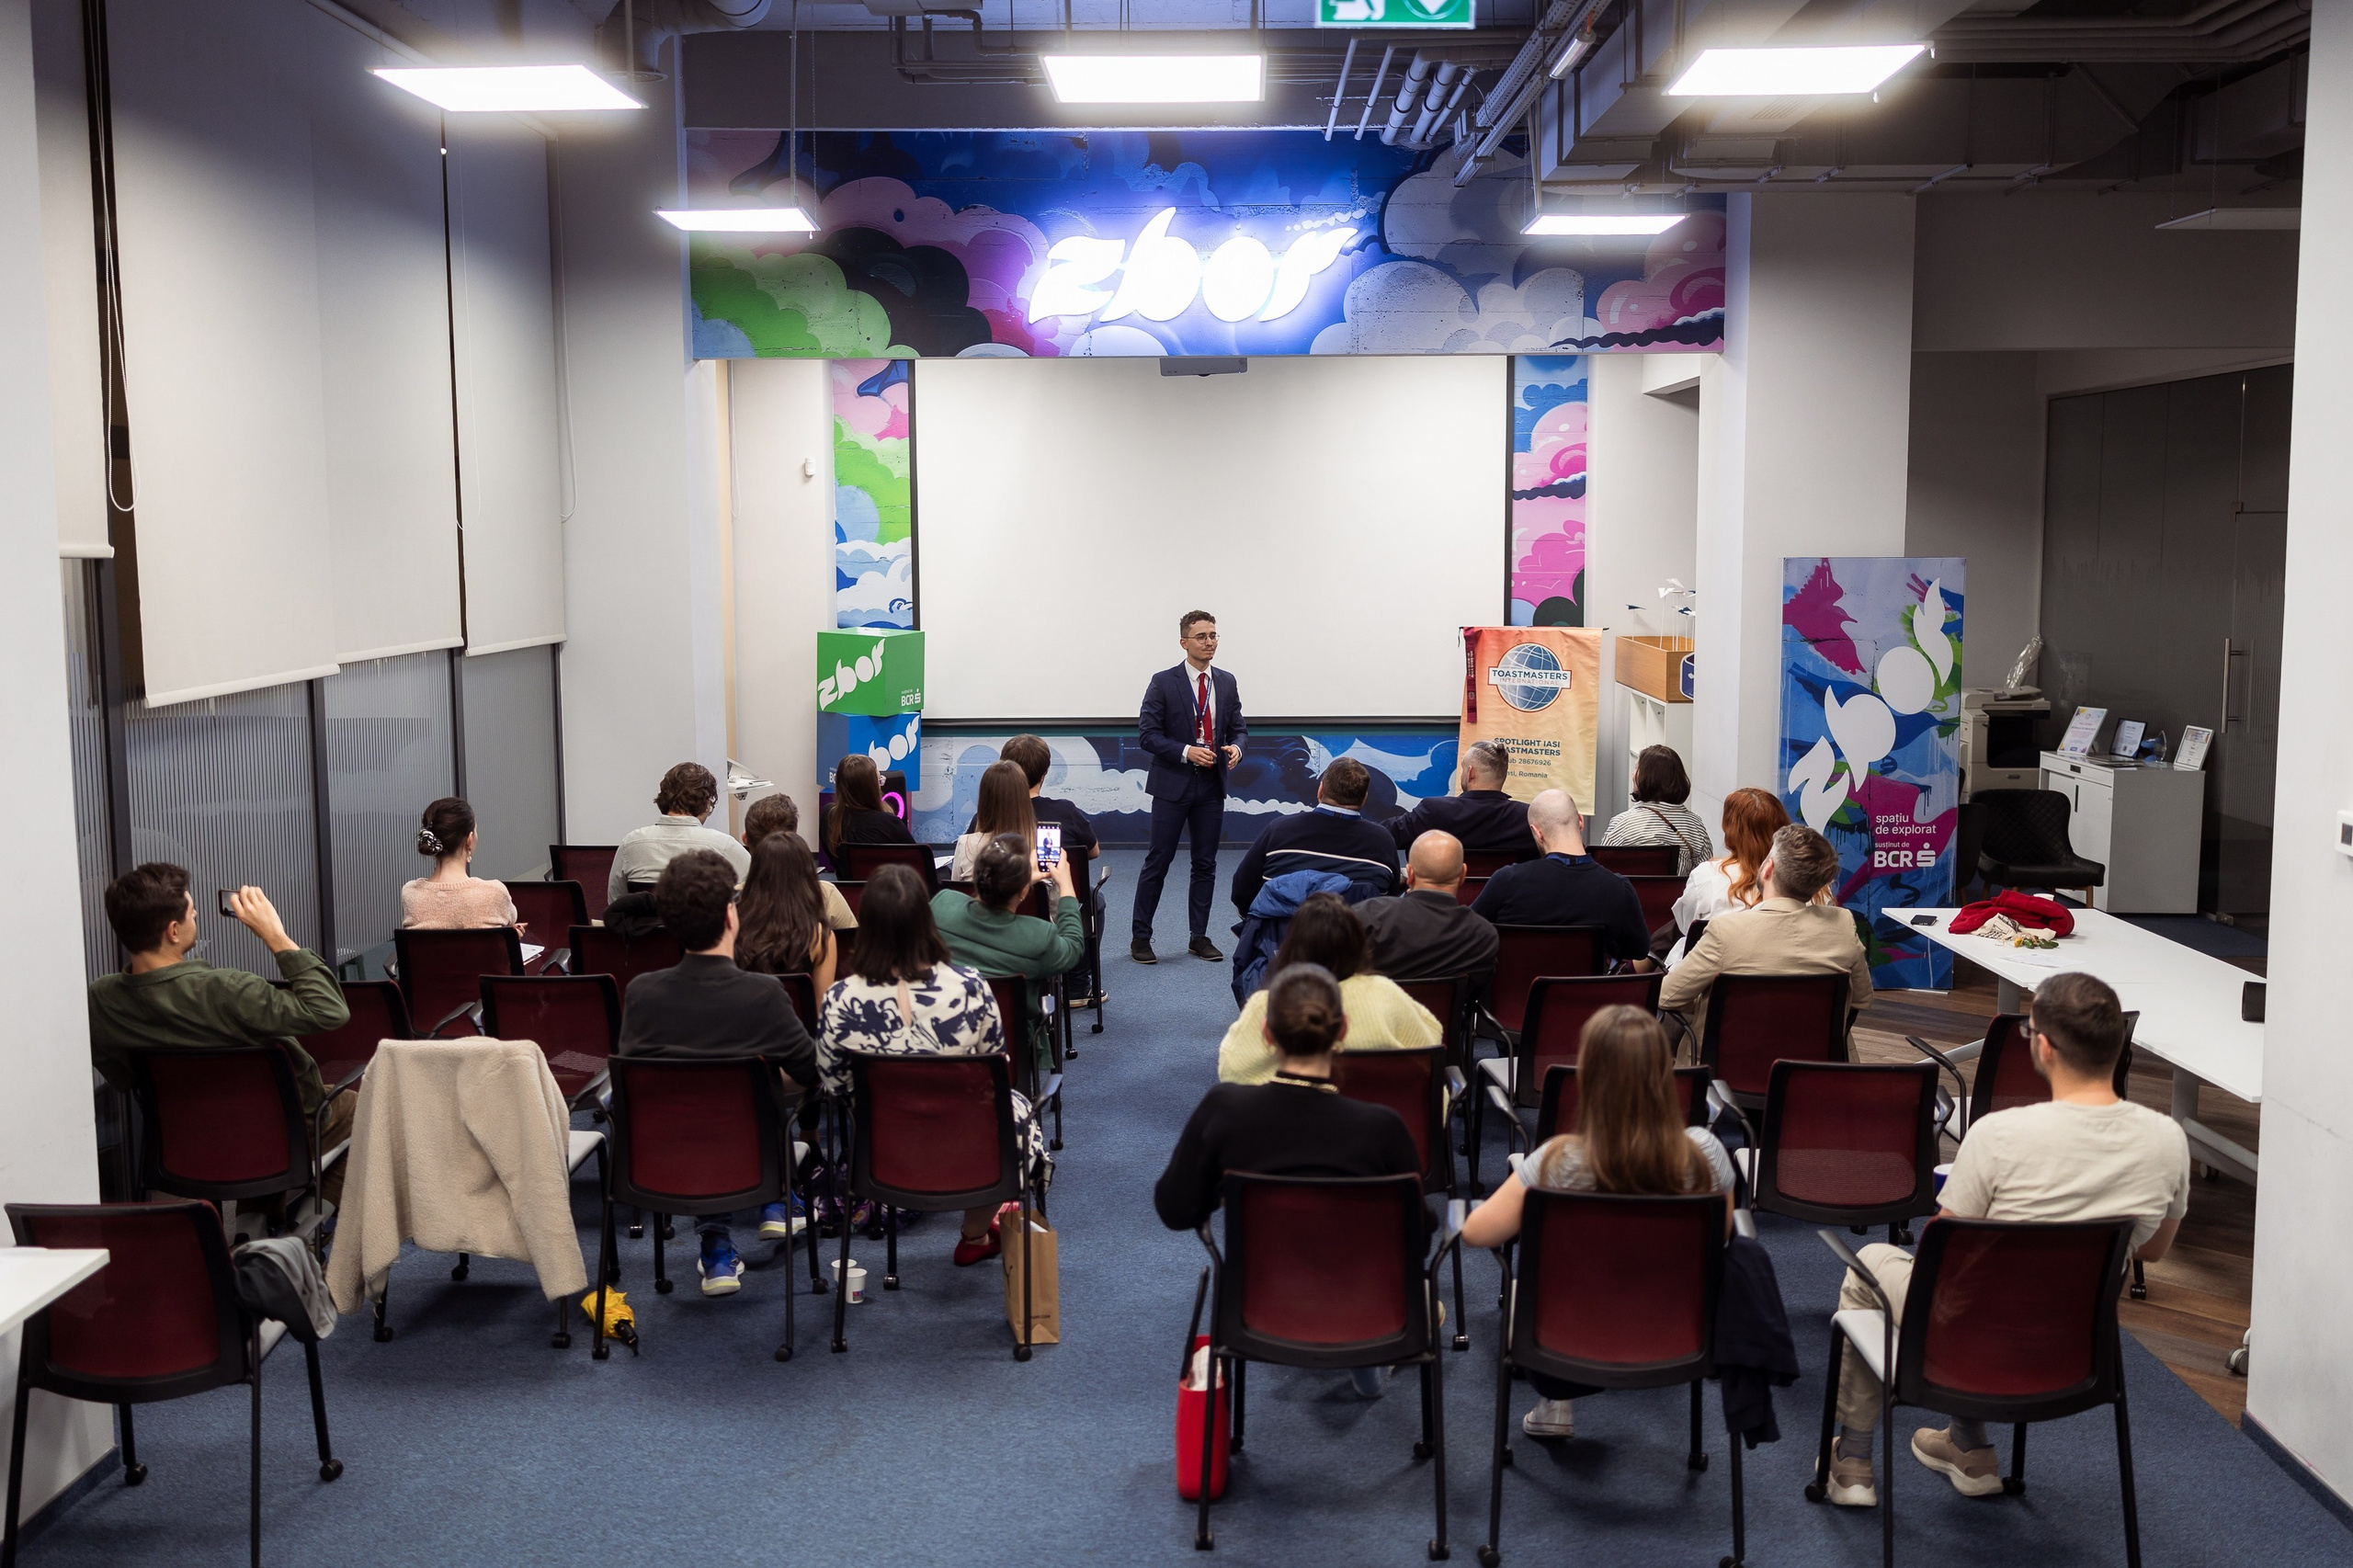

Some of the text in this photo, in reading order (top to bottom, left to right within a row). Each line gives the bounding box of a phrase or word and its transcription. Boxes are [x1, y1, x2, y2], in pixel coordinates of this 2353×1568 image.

[1029, 207, 1358, 324] zbor
[817, 638, 886, 711] zbor
[1492, 669, 1568, 680] TOASTMASTERS
[1499, 677, 1559, 686] INTERNATIONAL
[901, 694, 915, 707] BCR
[868, 714, 920, 771] bor
[1543, 740, 1561, 748] IASI
[1506, 746, 1561, 756] ASTMASTERS
[1518, 757, 1552, 766] 28676926
[1518, 770, 1548, 778] Romania
[1875, 812, 1909, 825] spațiu
[1875, 824, 1937, 836] de explorat
[1874, 850, 1914, 868] BCR
